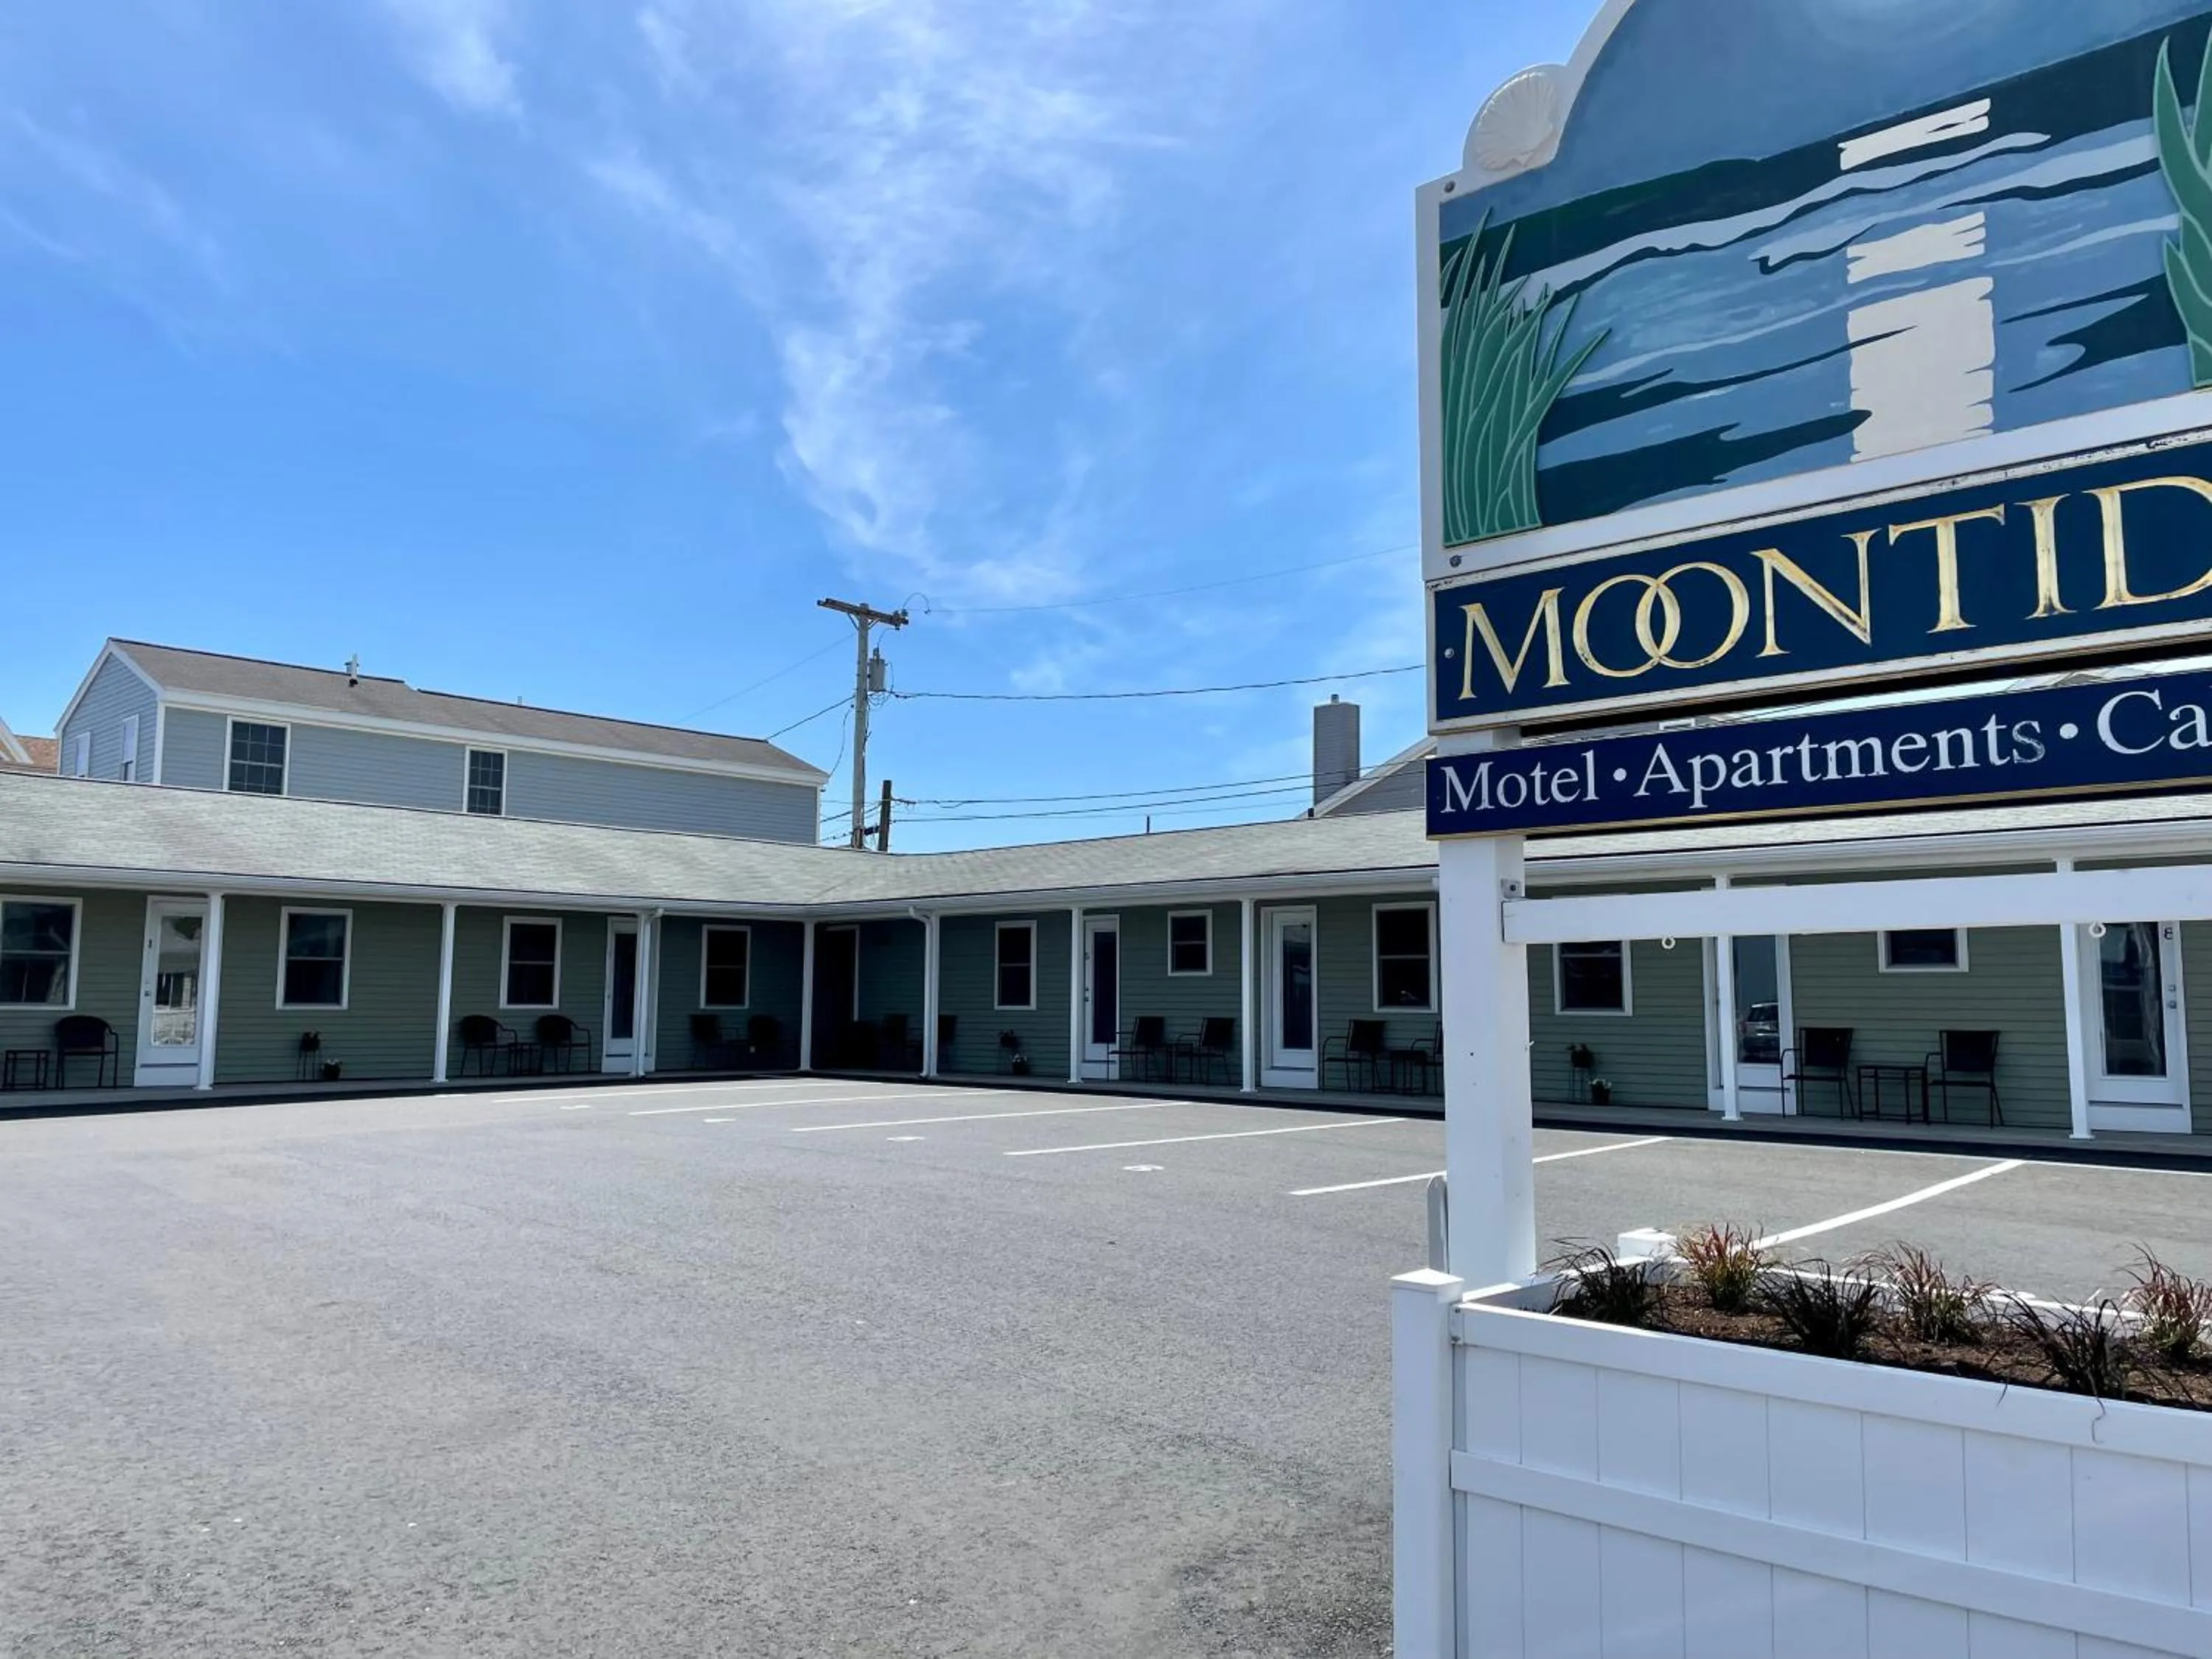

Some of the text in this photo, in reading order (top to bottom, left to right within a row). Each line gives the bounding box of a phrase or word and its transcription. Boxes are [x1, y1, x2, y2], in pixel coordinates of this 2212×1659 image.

[1458, 476, 2212, 700] MOONTID
[1441, 685, 2212, 813] Motel Apartments Ca
